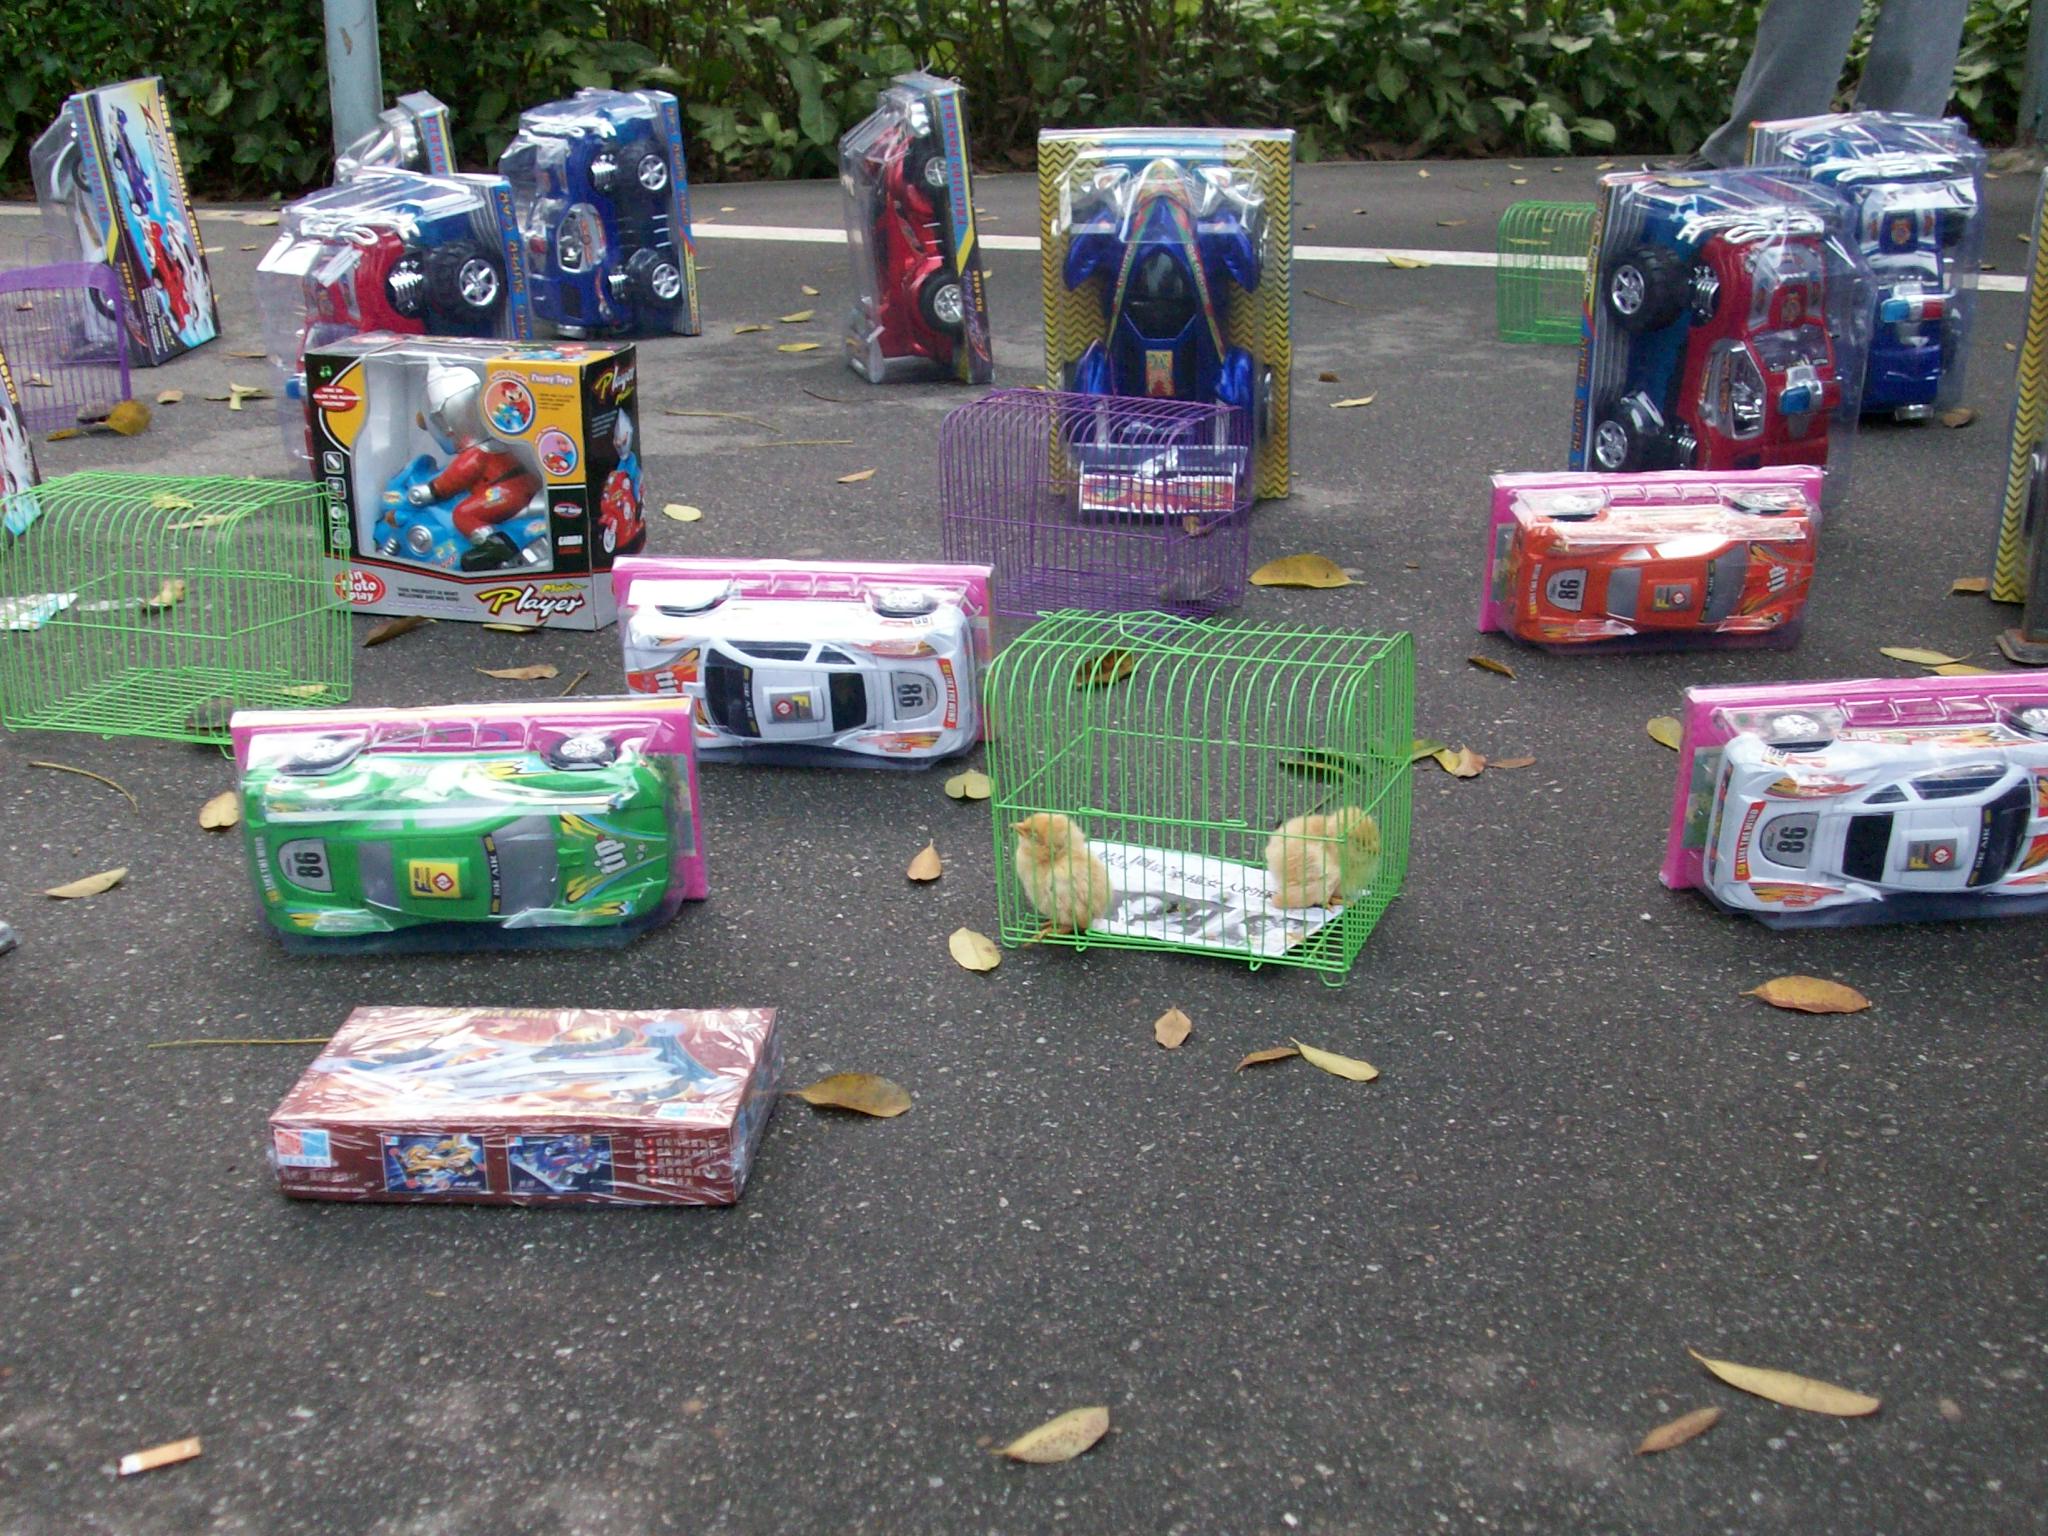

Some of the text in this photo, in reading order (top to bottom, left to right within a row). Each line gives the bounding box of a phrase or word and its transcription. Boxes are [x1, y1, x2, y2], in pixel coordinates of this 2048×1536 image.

[1558, 579, 1580, 600] 86
[477, 584, 584, 620] Player
[897, 684, 924, 708] 86
[1742, 809, 1758, 830] WIND
[1740, 832, 1752, 846] THE
[1776, 826, 1808, 854] 86
[294, 852, 323, 878] 86
[594, 840, 627, 874] tip
[1736, 847, 1749, 864] LIKE
